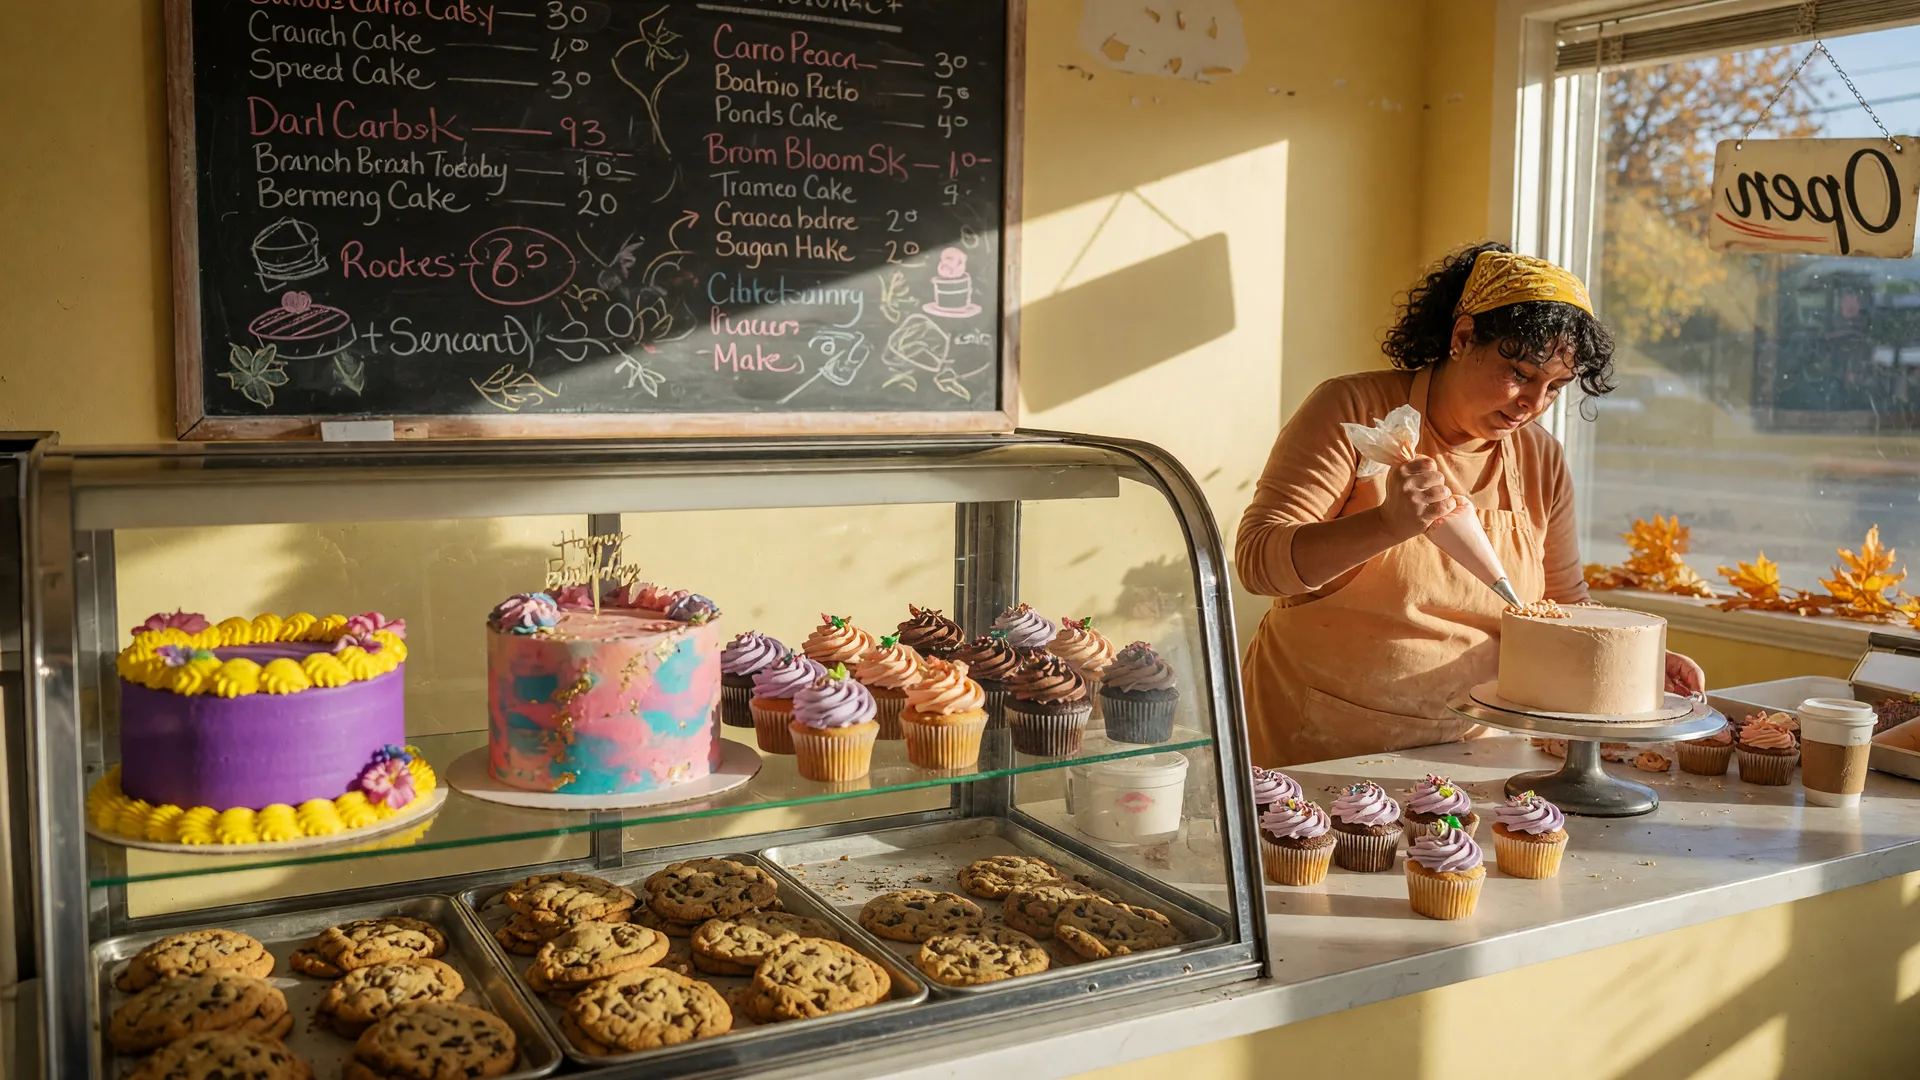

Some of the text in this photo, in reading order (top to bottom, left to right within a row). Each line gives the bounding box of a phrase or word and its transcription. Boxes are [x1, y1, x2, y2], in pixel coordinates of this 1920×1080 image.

[352, 20, 436, 54] Cake
[352, 55, 437, 90] Cake
[715, 95, 784, 127] Ponds
[789, 102, 844, 131] Cake
[388, 180, 471, 213] Cake
[803, 174, 858, 204] Cake
